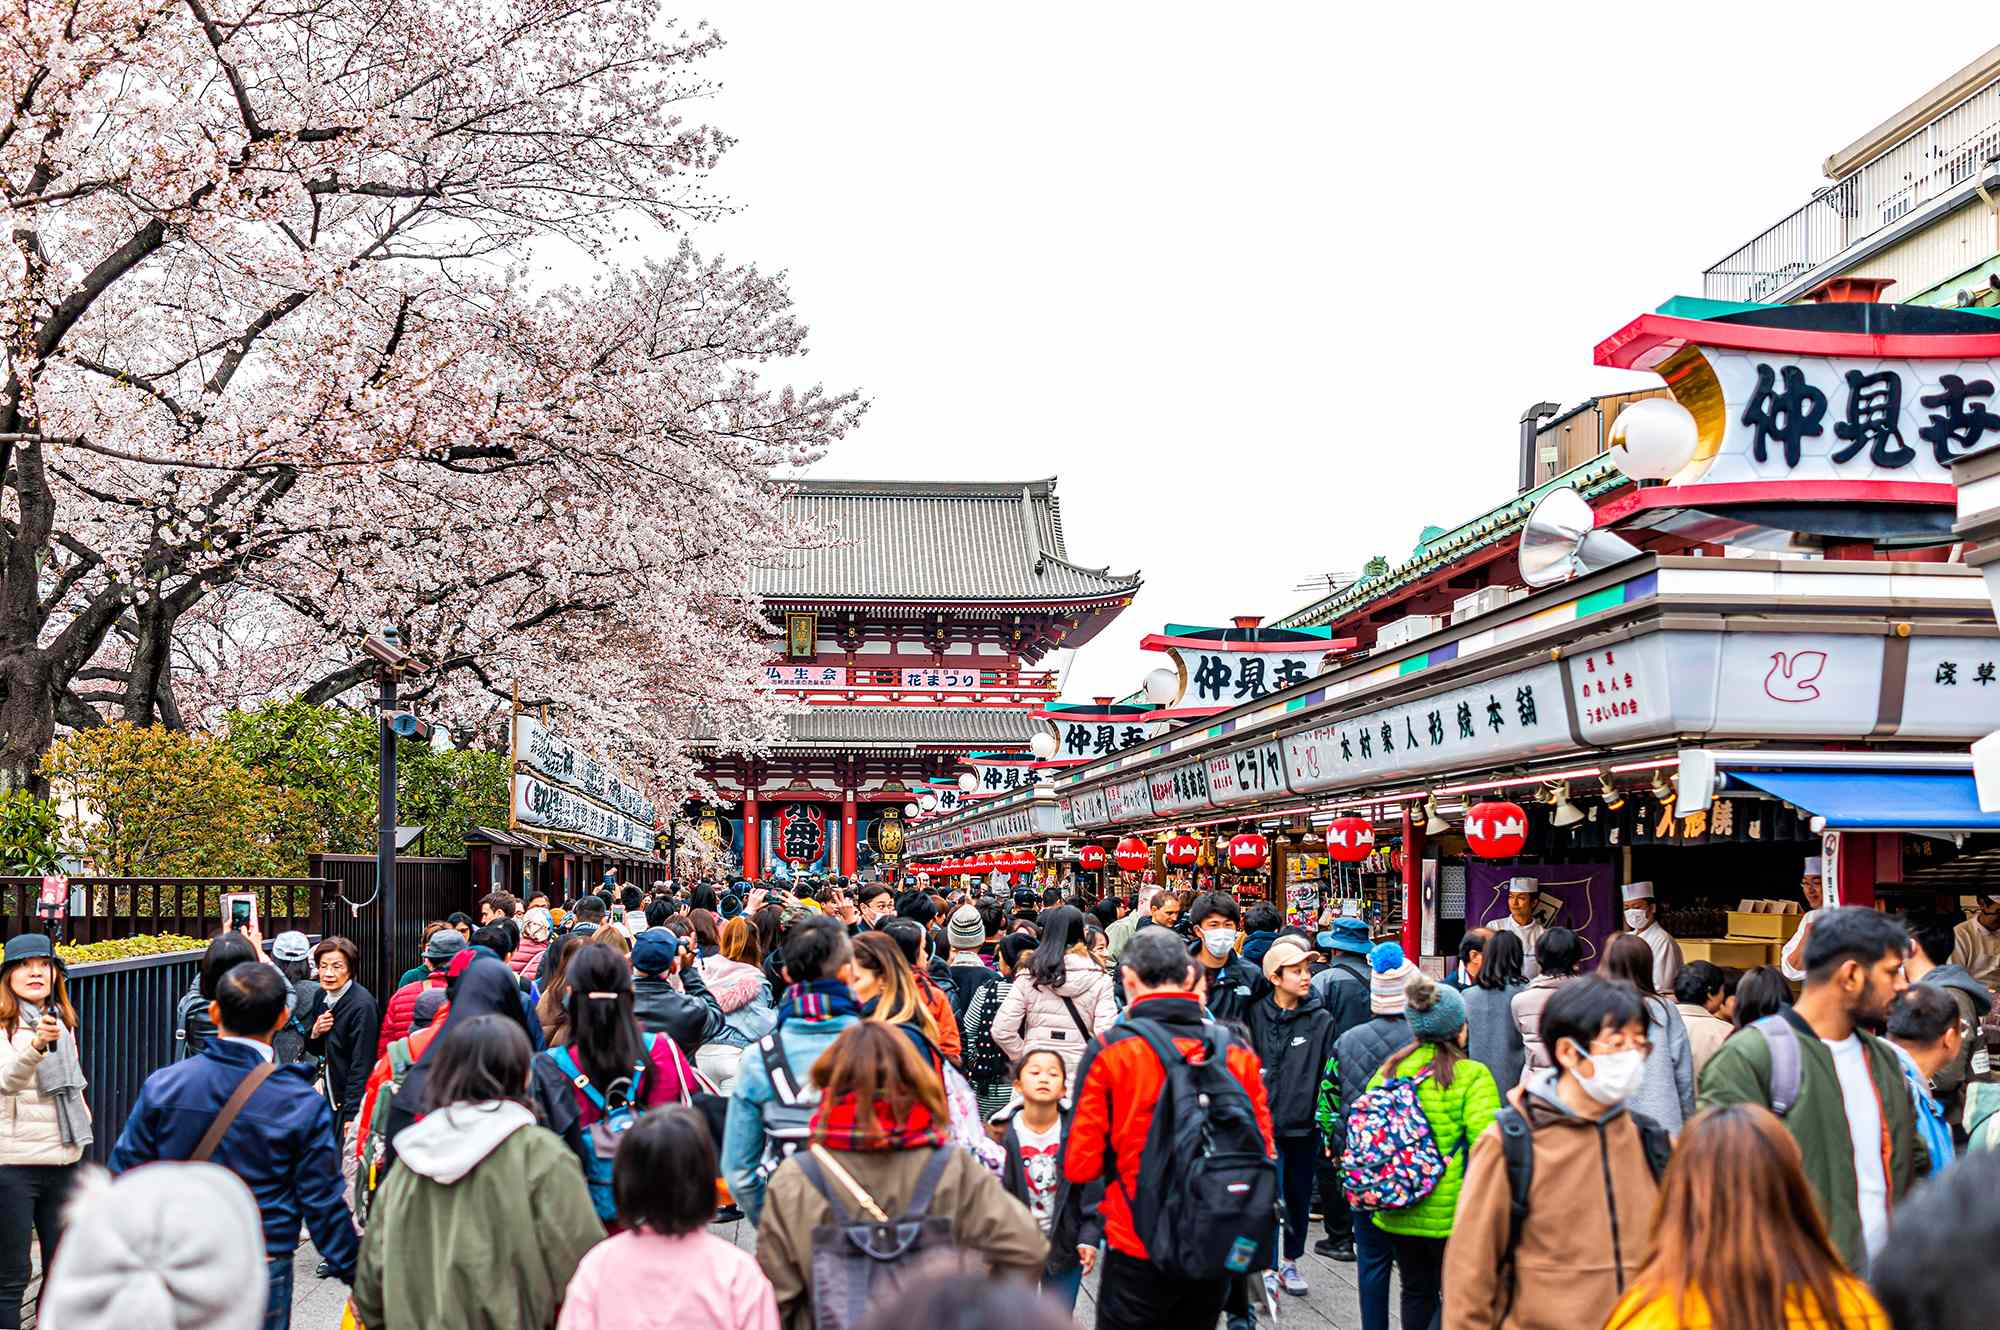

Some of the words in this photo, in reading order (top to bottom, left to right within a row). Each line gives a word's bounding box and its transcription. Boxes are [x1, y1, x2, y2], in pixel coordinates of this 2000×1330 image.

[767, 667, 837, 680] 仏生会
[908, 674, 974, 686] 花まつり
[784, 803, 822, 860] 小舟町
